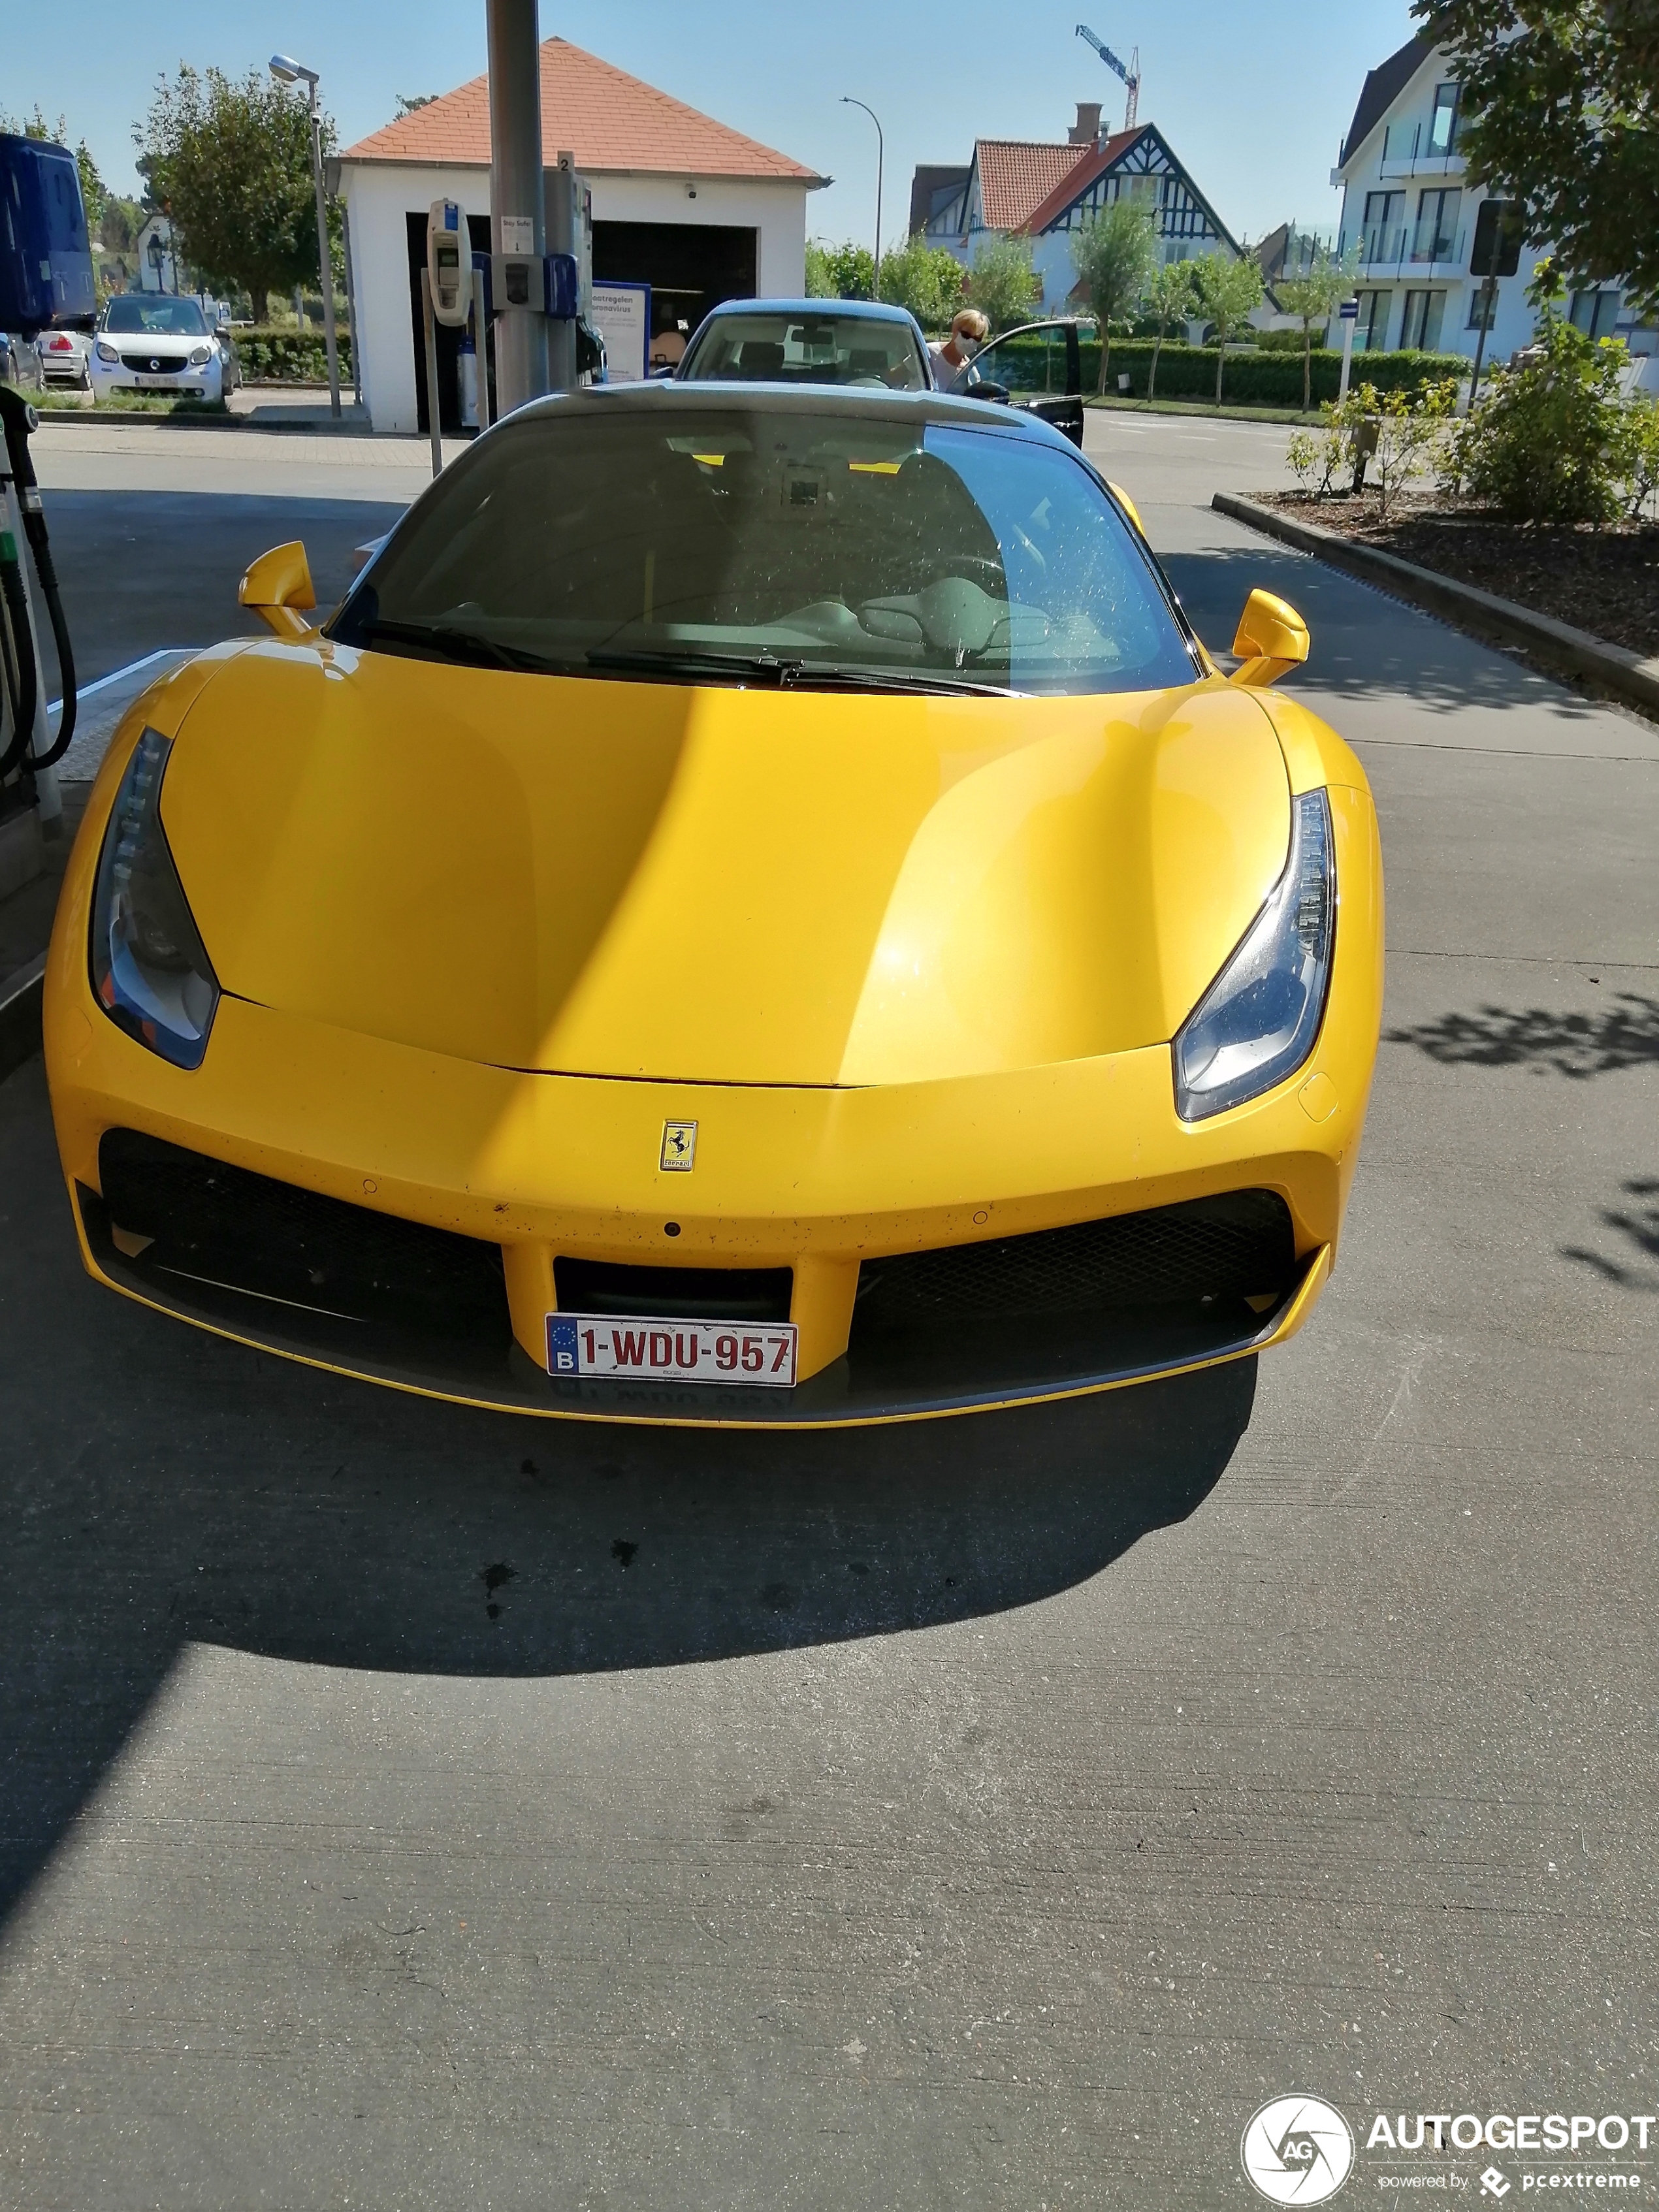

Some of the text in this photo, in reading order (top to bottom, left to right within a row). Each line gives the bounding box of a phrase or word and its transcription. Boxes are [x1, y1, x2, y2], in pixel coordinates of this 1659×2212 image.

[560, 159, 569, 171] 2
[592, 295, 633, 304] aatregelen
[581, 1329, 790, 1373] 1-WDU-957
[556, 1351, 574, 1370] B
